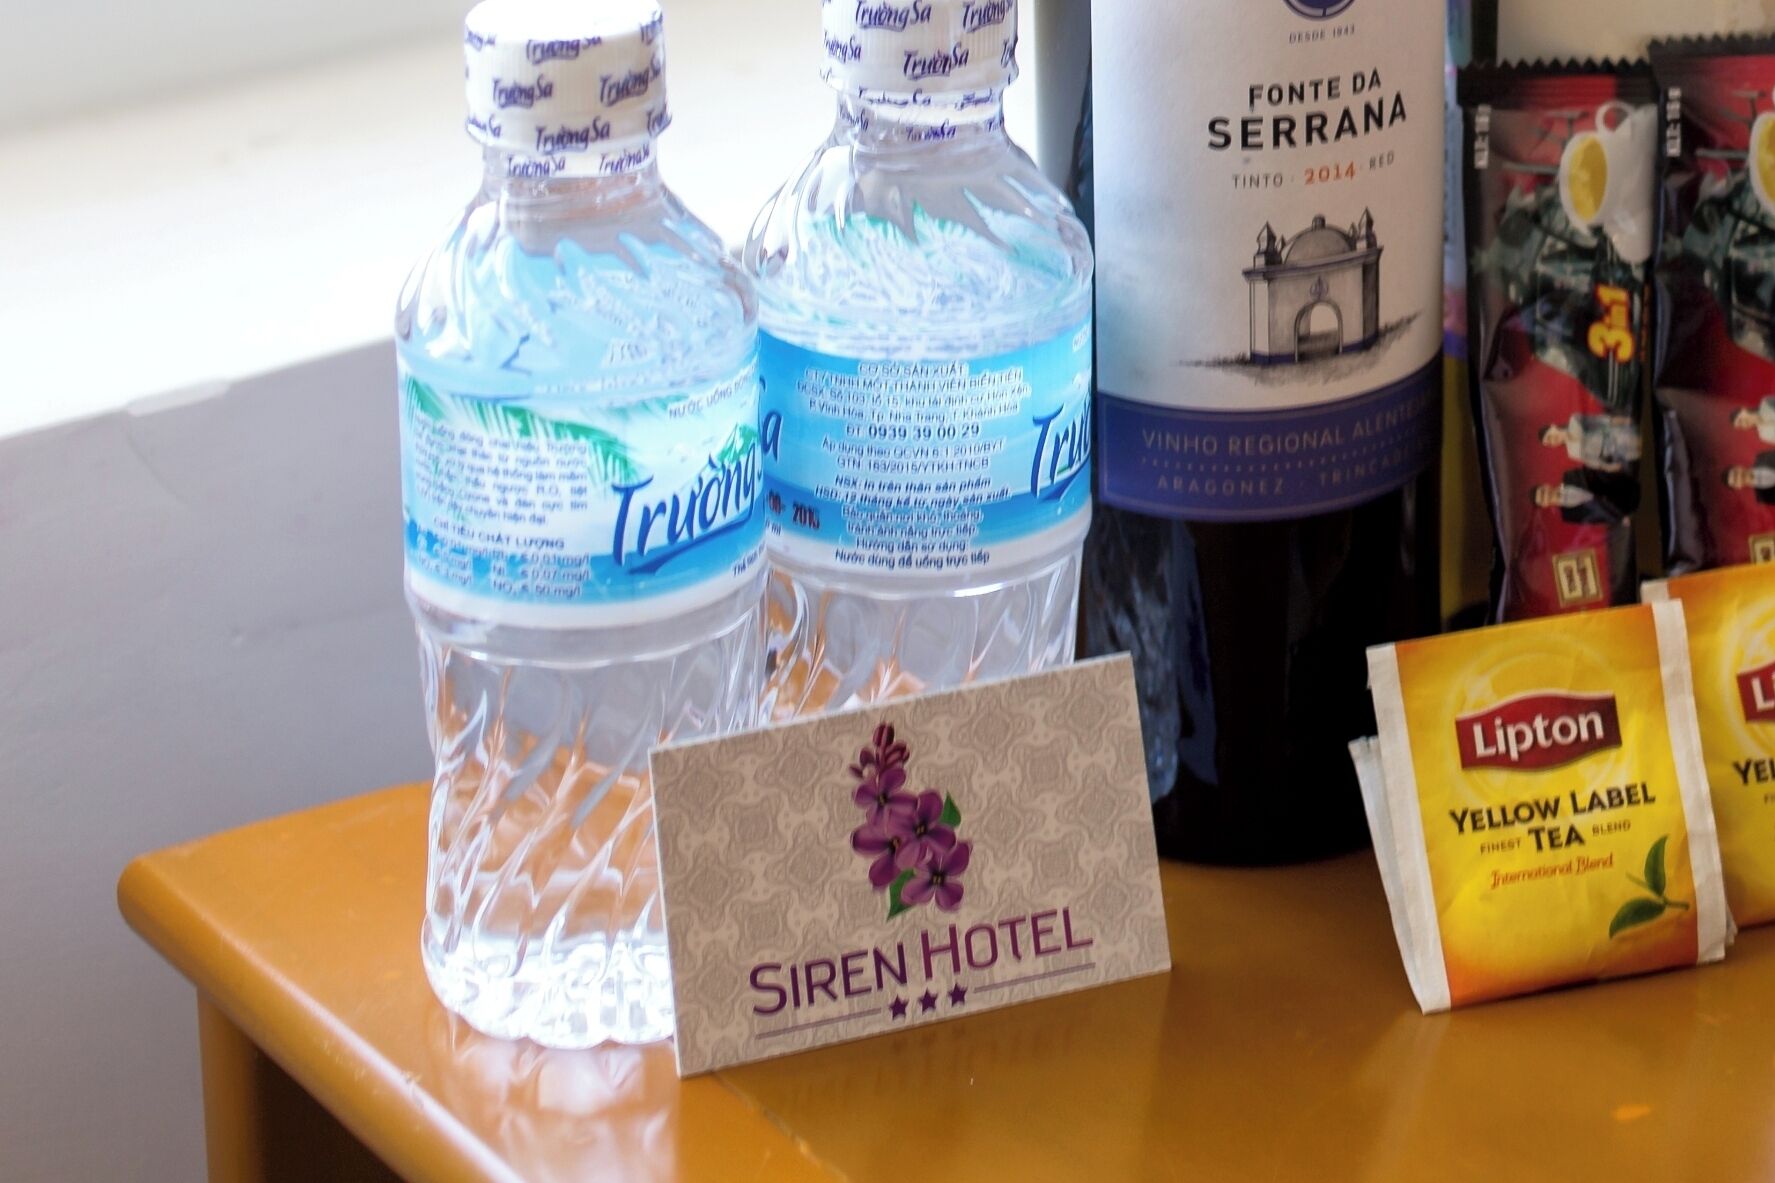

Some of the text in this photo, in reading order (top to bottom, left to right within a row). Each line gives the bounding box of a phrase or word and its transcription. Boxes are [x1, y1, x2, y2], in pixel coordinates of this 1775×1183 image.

[951, 41, 969, 67] Sa
[1289, 29, 1326, 44] DESDE
[535, 74, 554, 100] Sa
[1249, 67, 1382, 111] FONTE DA
[535, 116, 611, 153] Trường Sa
[1208, 91, 1407, 151] SERRANA
[1231, 150, 1395, 190] TINTO 2014 RED
[868, 425, 907, 439] 0939
[912, 426, 932, 440] 39
[937, 425, 956, 439] 00
[961, 423, 980, 438] 29
[1141, 425, 1345, 457] VINHO REGIONAL
[611, 442, 763, 566] Trường
[1157, 474, 1285, 497] ARAGONEZ
[835, 548, 866, 563] Nước
[867, 552, 895, 570] dùng
[915, 551, 944, 569] uống
[970, 548, 990, 564] tiếp
[1472, 711, 1605, 762] Lipton
[1449, 782, 1656, 834] YELLOW LABEL
[1480, 819, 1632, 855] FINEST TEA BLEND
[1491, 852, 1614, 890] International Blend
[750, 907, 1094, 1015] SIREN HOTEL
